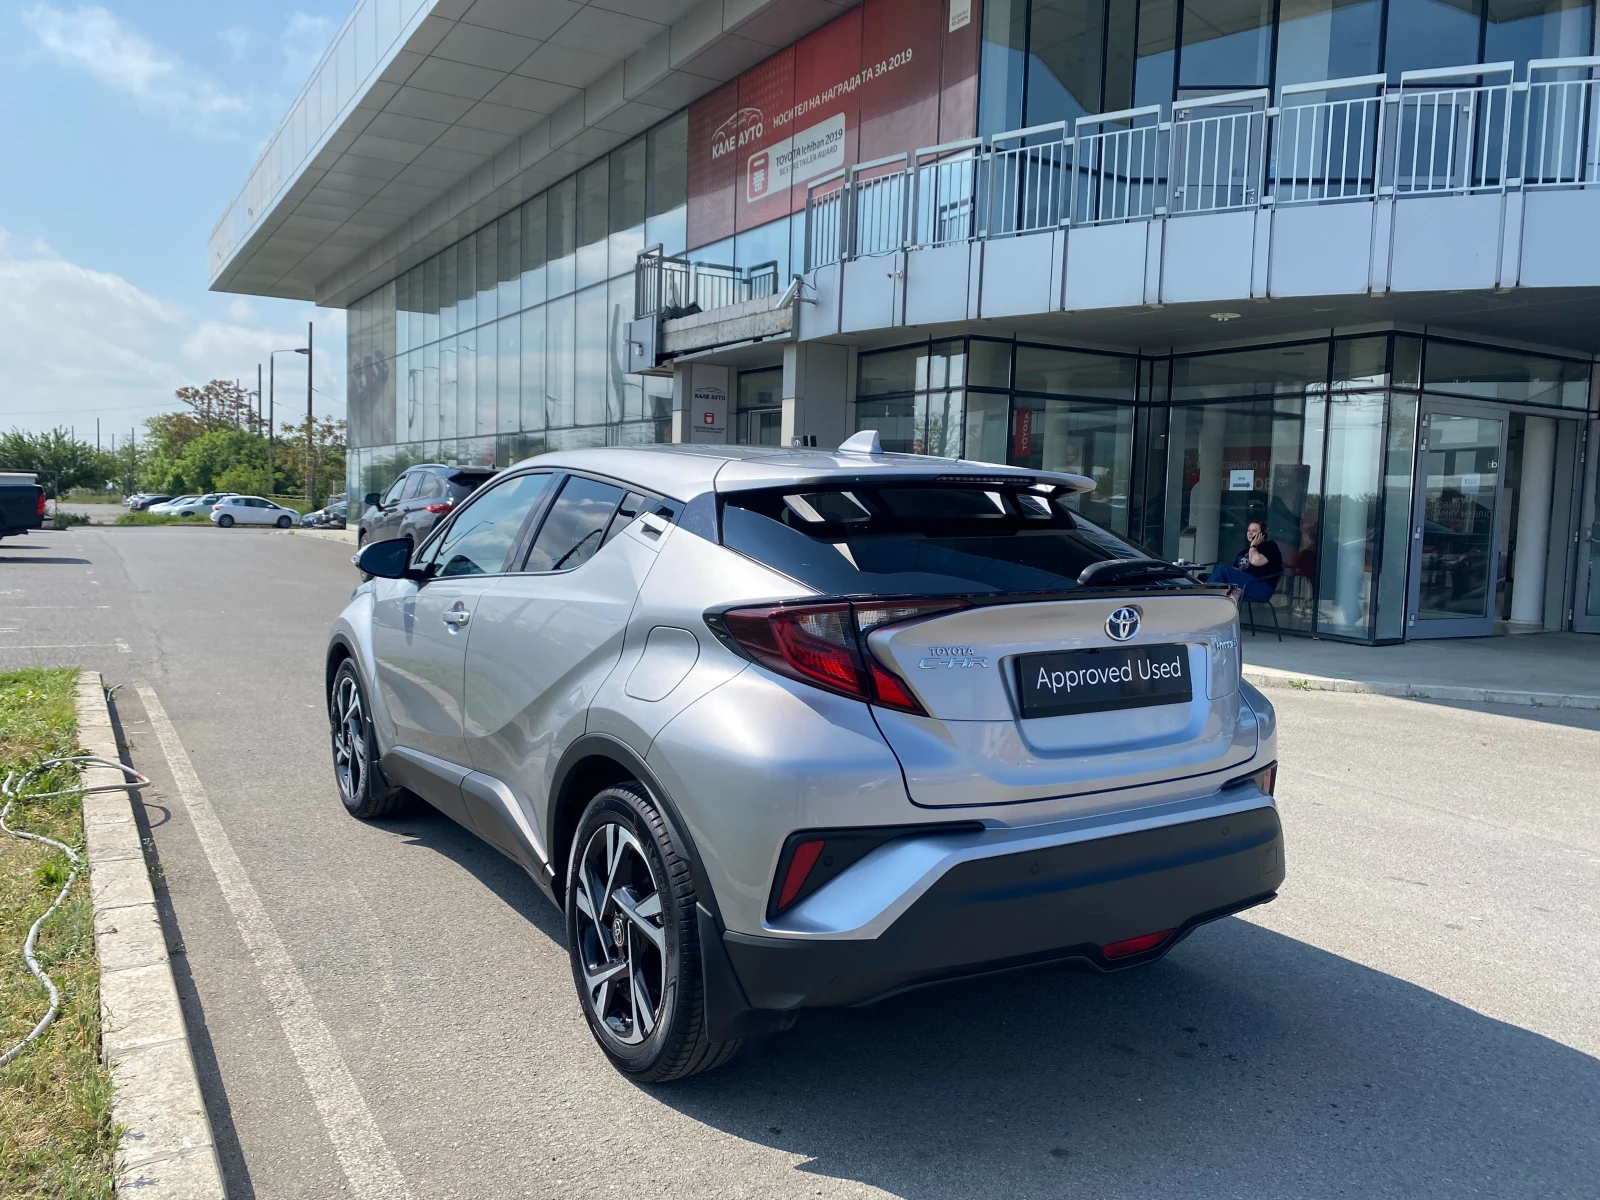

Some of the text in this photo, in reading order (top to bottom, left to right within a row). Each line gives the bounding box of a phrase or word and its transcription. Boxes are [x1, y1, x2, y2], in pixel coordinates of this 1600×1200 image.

[773, 101, 808, 128] НОСИТЕЛ
[809, 95, 820, 110] НА
[874, 60, 887, 77] ЗА
[888, 48, 912, 71] 2019
[712, 122, 763, 159] КАЛЕ АУТО
[776, 128, 843, 167] TOYOTA Ichiban 2019
[779, 144, 838, 176] BEST RETAILER AWARD
[1021, 411, 1030, 451] TOYOTA
[1430, 509, 1459, 517] CAMRY
[918, 656, 989, 669] C-HR
[928, 646, 975, 656] TOYOTA
[1036, 655, 1182, 694] Approved Used
